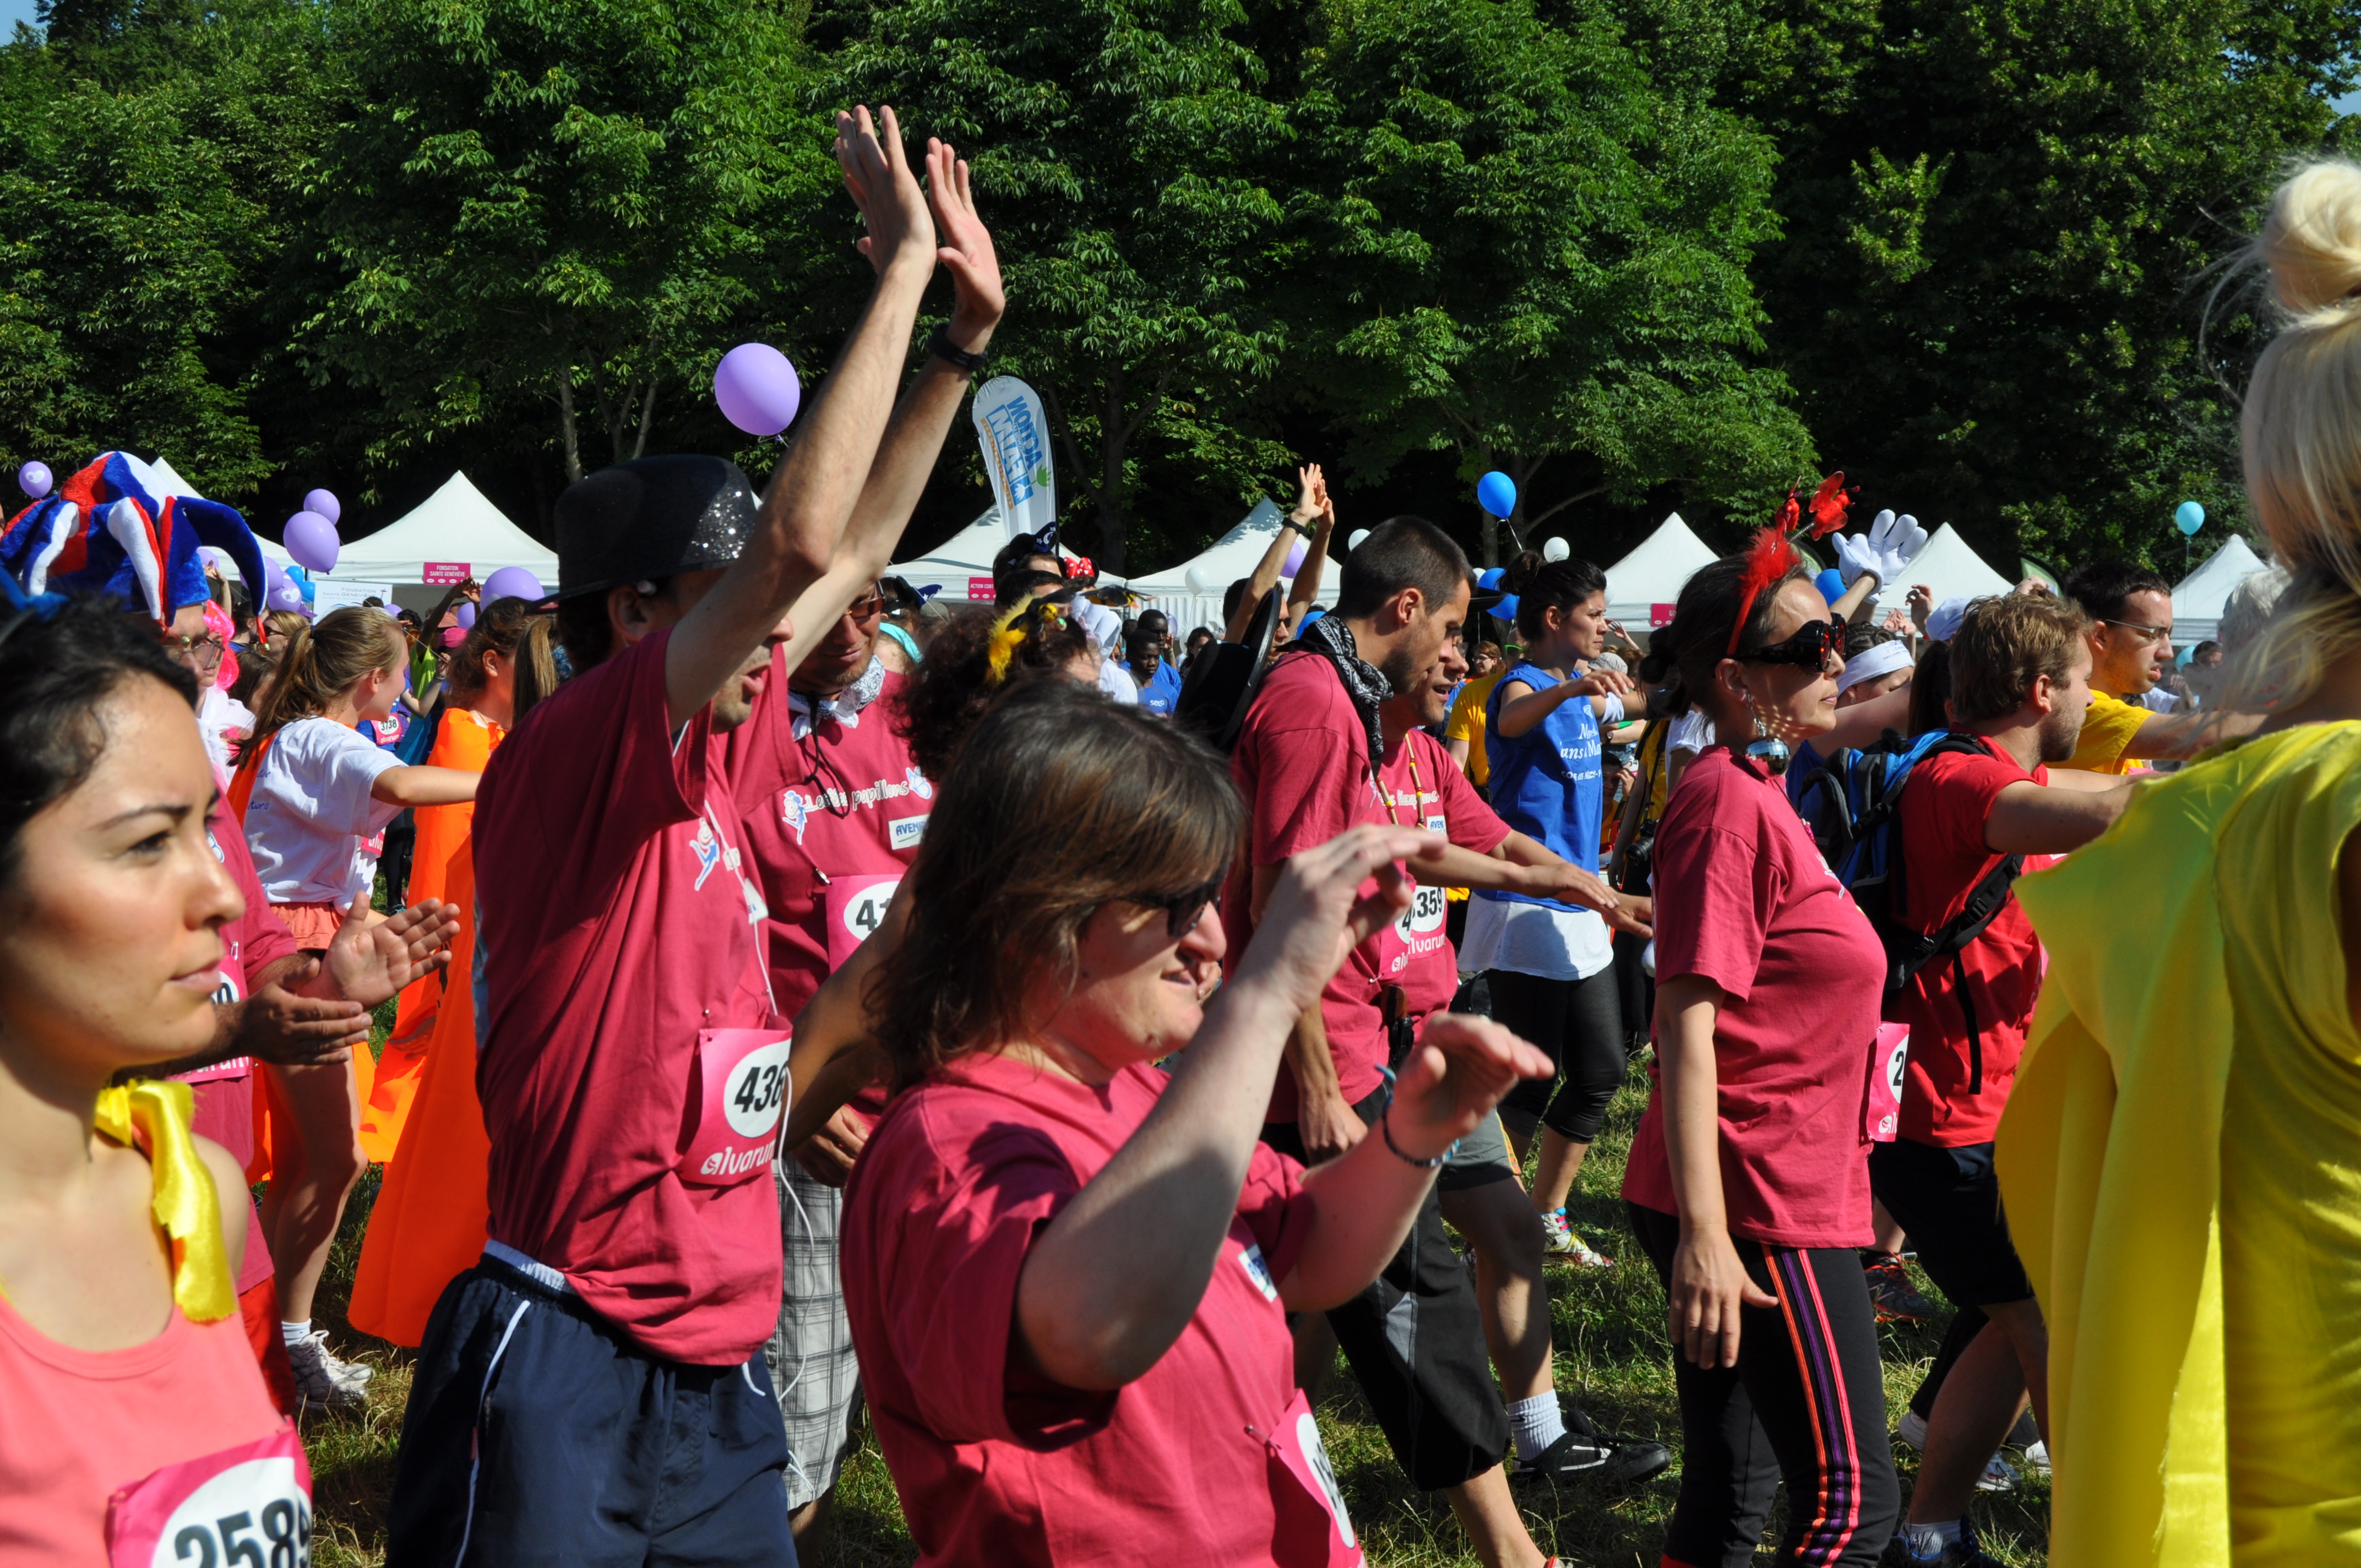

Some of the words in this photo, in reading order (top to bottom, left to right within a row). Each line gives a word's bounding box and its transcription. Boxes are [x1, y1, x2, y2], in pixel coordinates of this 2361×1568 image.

[851, 778, 910, 812] papillons
[1412, 887, 1443, 918] 359
[1893, 1050, 1905, 1086] 2
